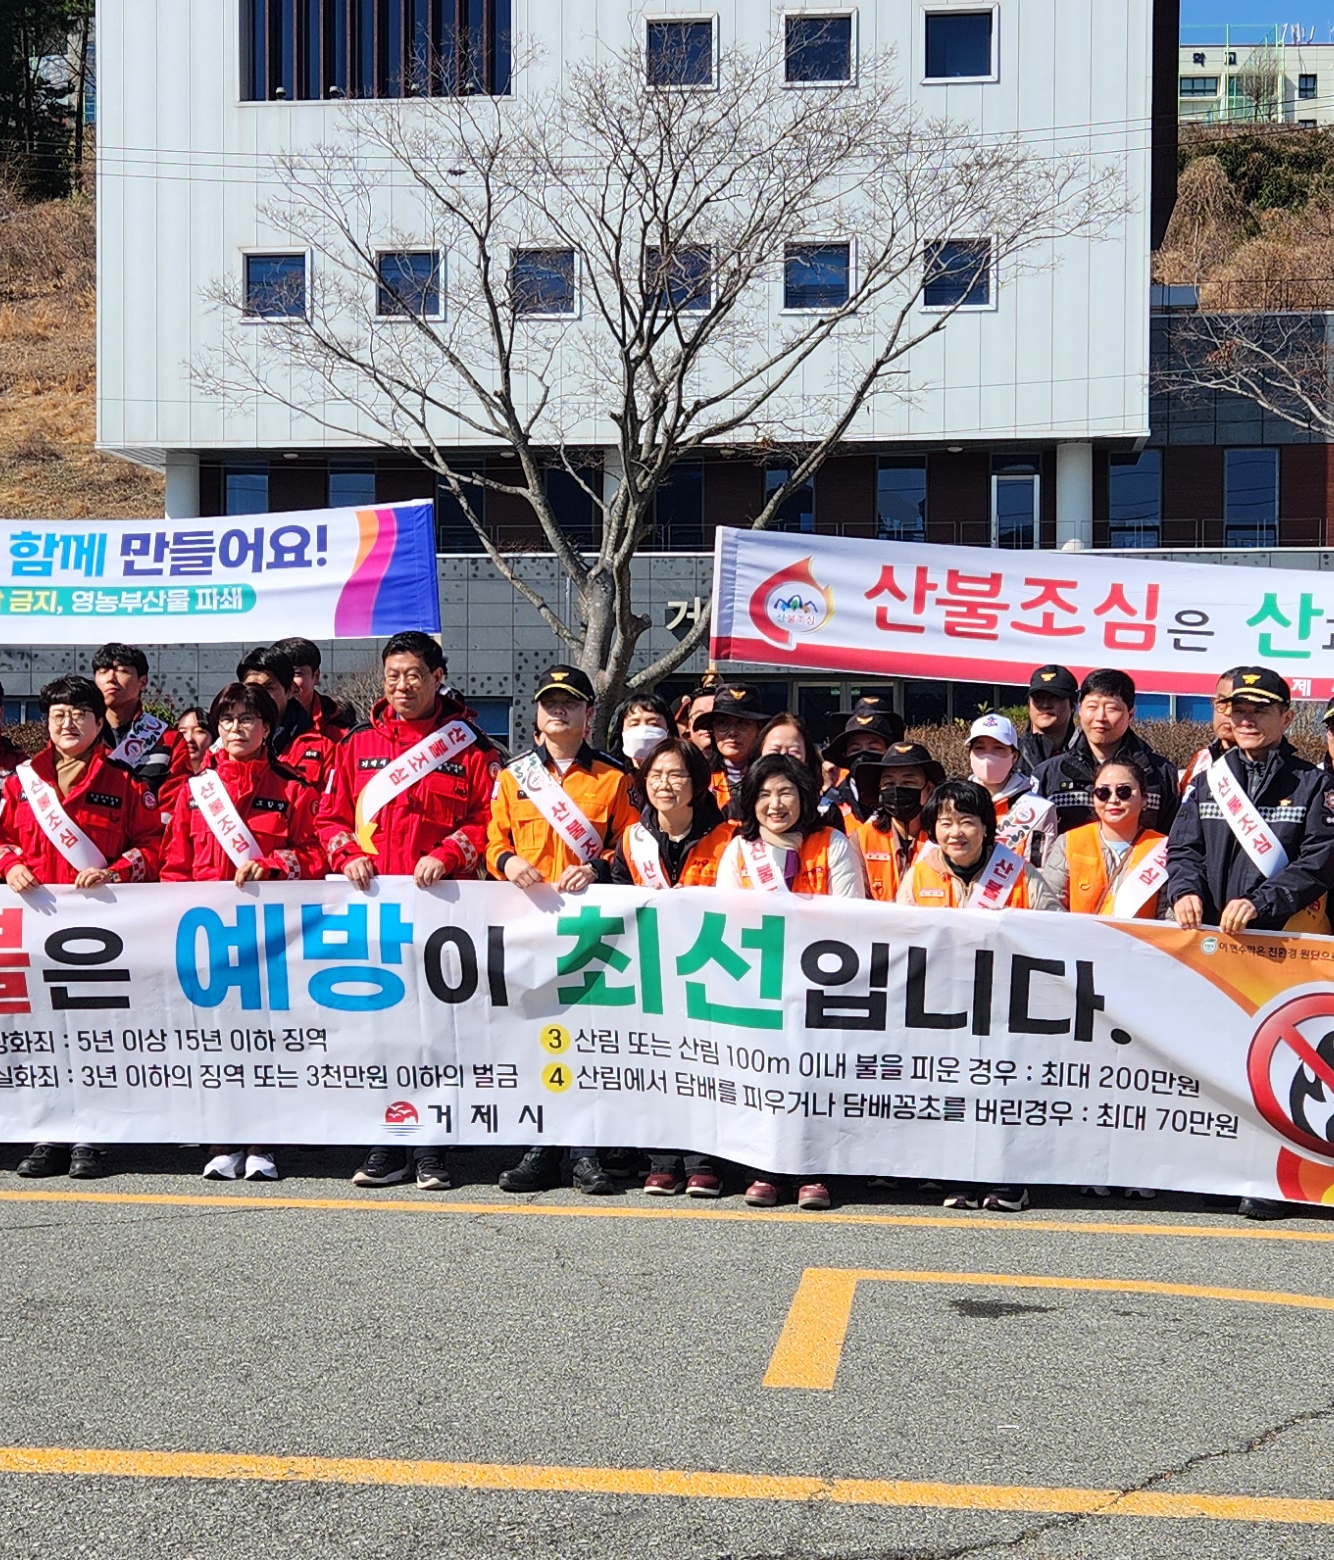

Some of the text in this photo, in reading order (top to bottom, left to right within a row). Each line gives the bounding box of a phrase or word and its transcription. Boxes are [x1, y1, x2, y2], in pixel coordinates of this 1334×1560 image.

[8, 529, 108, 578] 함께
[119, 524, 330, 578] 만들어요!
[8, 586, 63, 615] 금지,
[71, 586, 190, 615] 영농부산물
[194, 585, 243, 611] 파쇄
[776, 612, 815, 625] 산불조심
[864, 562, 1215, 653] 산불조심은
[387, 725, 468, 787] 산불조심
[29, 779, 80, 850] 산불조심
[198, 780, 251, 856] 산불조심
[551, 800, 601, 860] 산불조
[1216, 775, 1274, 856] 산불조심
[175, 902, 509, 1012] 예방이
[556, 904, 1133, 1047] 최선입니다.
[1267, 946, 1298, 960] 친환경
[77, 1029, 115, 1054] 5년
[123, 1029, 168, 1053] 이상
[174, 1028, 223, 1053] 15년
[230, 1028, 277, 1053] 이하
[283, 1028, 328, 1053] 징역
[574, 1028, 620, 1056] 산림
[628, 1031, 673, 1060] 또는
[678, 1036, 721, 1066] 산림
[726, 1043, 791, 1075] 100m
[798, 1051, 847, 1080] 이내
[855, 1051, 905, 1081] 불을
[910, 1054, 961, 1084] 피운
[968, 1057, 1018, 1086] 경우
[1040, 1060, 1091, 1091] 최대
[1099, 1064, 1201, 1099] 200만원
[80, 1064, 118, 1089] 3년
[126, 1063, 193, 1089] 이하의
[200, 1063, 245, 1089] 징역
[253, 1064, 300, 1089] 또는
[305, 1063, 389, 1090] 3천만원
[396, 1063, 464, 1090] 이하의
[472, 1062, 519, 1090] 벌금
[575, 1065, 668, 1096] 산림에서
[675, 1070, 738, 1104] 담배를
[743, 1084, 836, 1119] 피우거나
[843, 1092, 967, 1123] 담배꽁초를
[975, 1097, 1074, 1128] 버린경우
[1095, 1102, 1147, 1132] 최대
[1154, 1107, 1239, 1140] 70만원
[426, 1103, 544, 1135] 거제시
